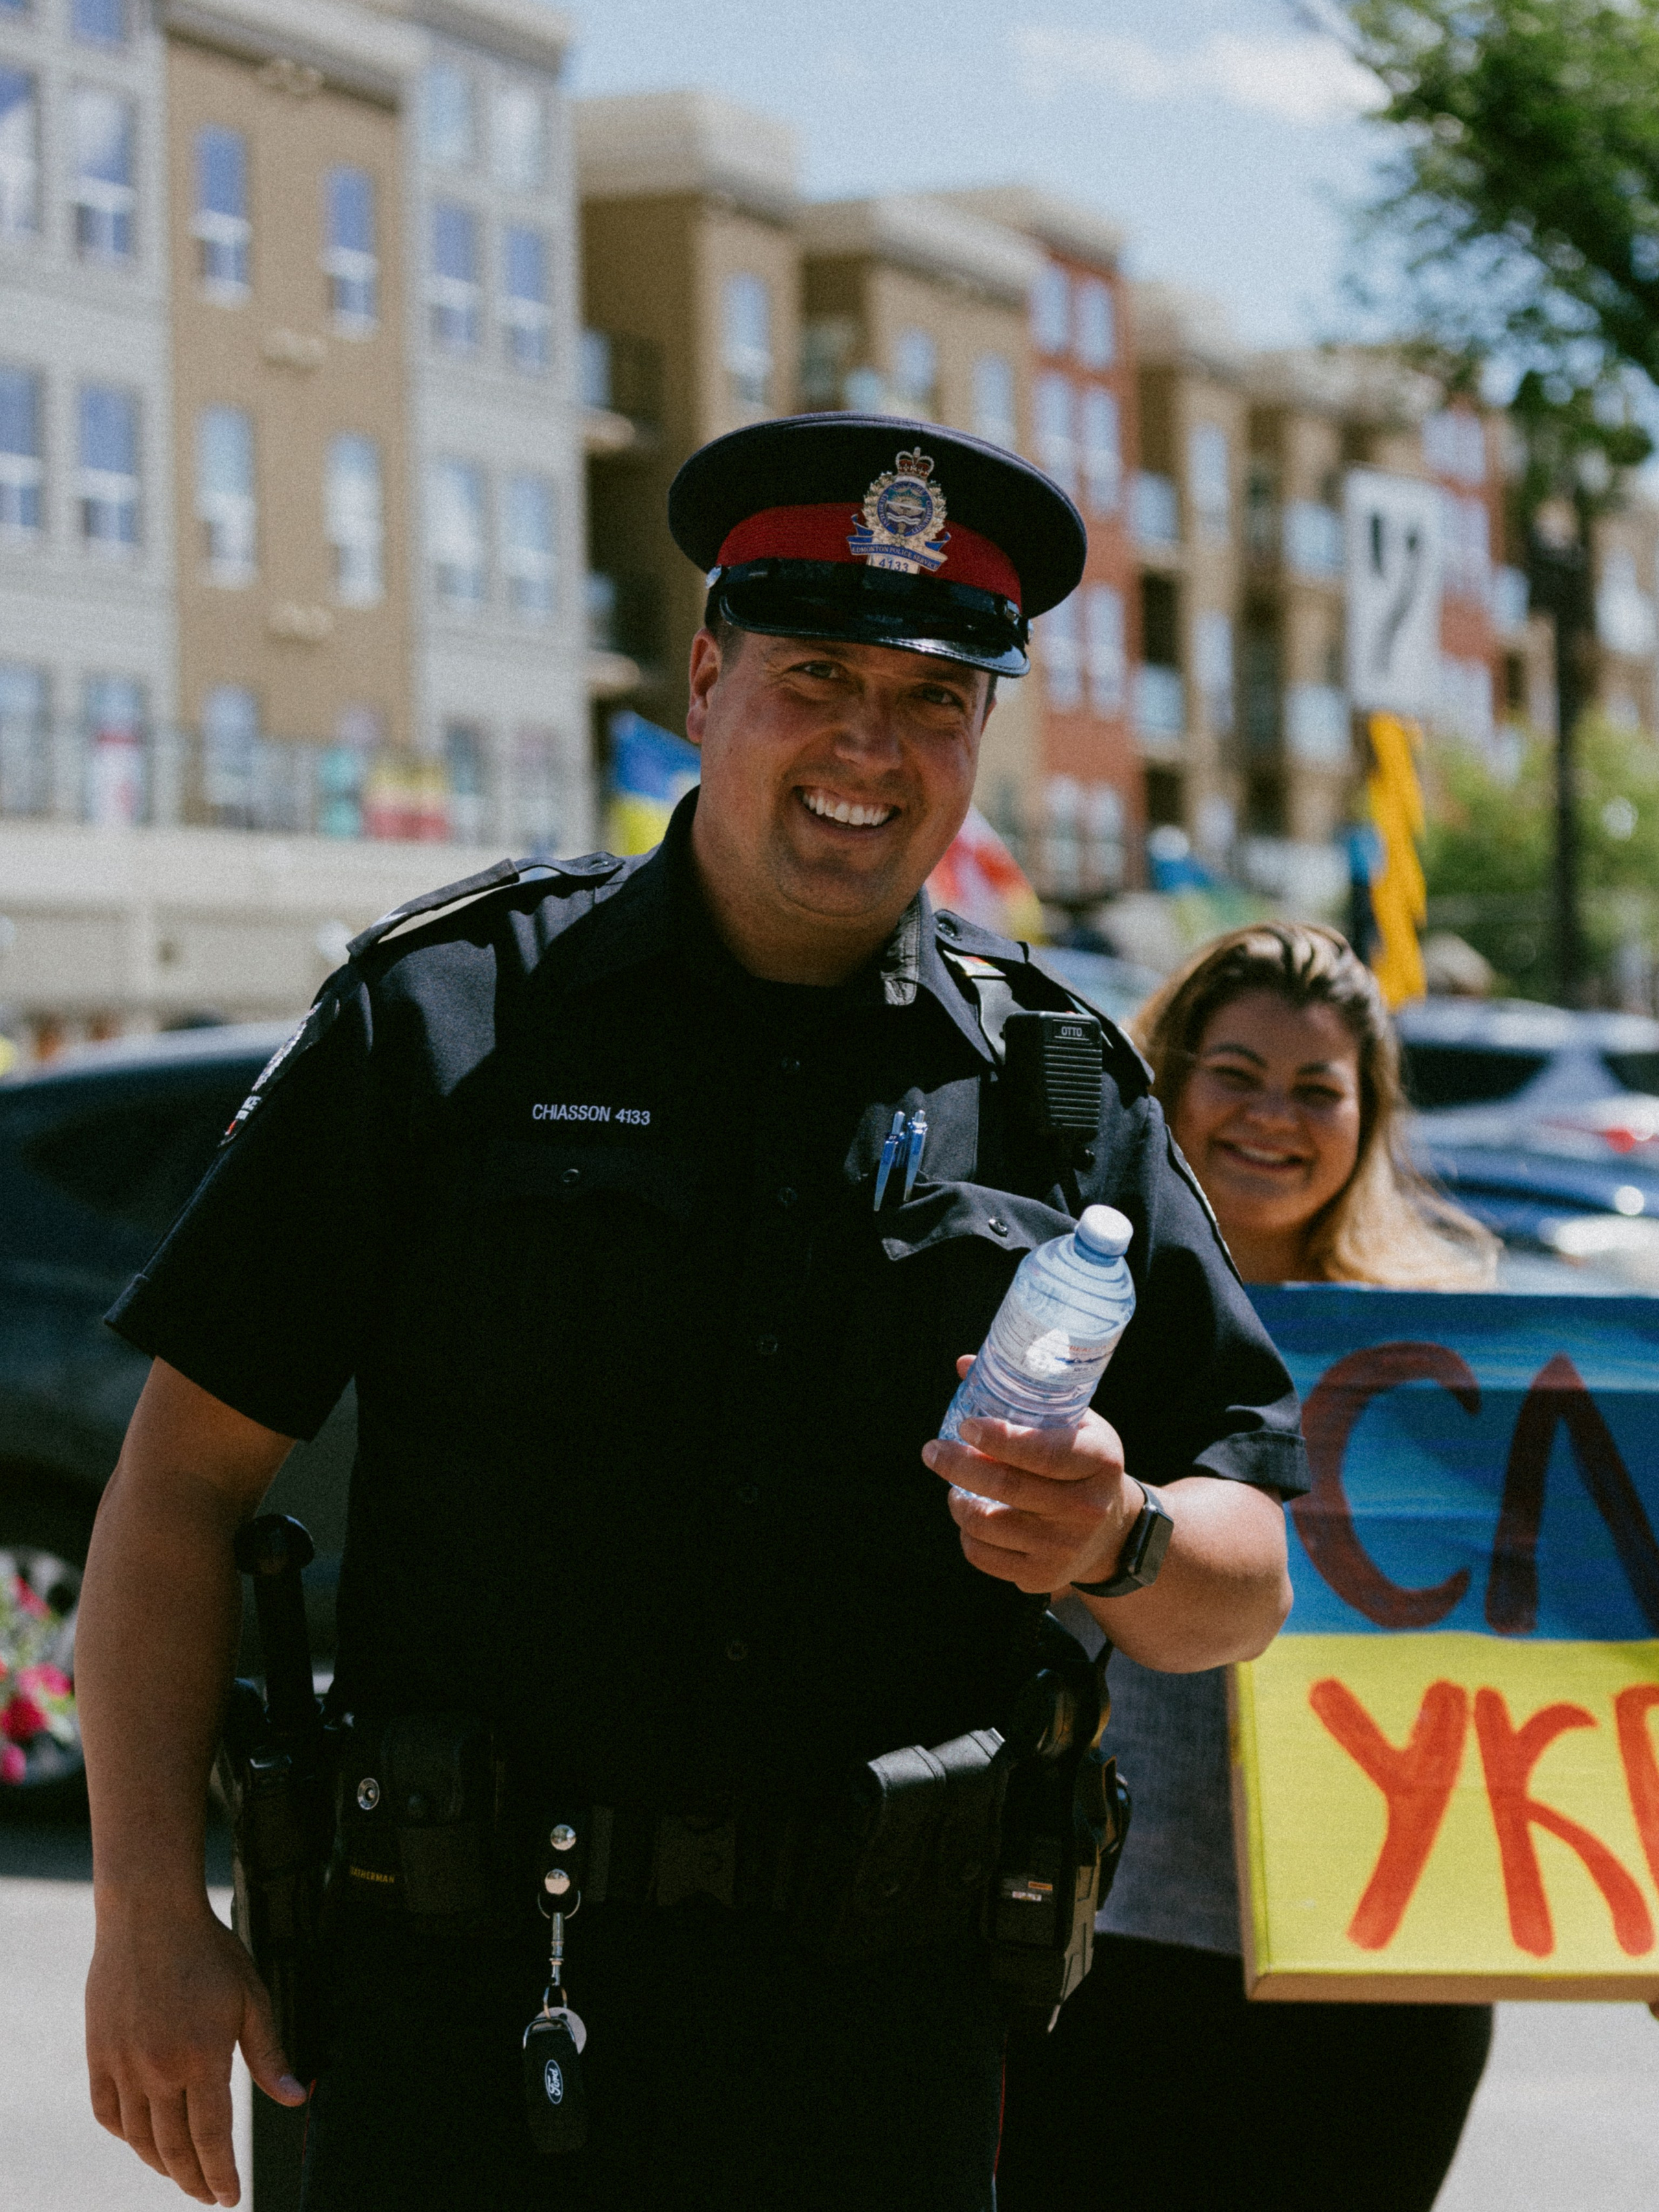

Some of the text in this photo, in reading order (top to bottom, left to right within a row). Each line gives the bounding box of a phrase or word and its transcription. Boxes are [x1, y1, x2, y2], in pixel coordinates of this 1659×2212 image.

[879, 559, 909, 572] 4133
[890, 547, 912, 558] POLICE
[914, 555, 938, 570] SERVICE
[1061, 1026, 1082, 1037] OTTO
[532, 1104, 651, 1126] CHIASSON 4133
[548, 2067, 561, 2096] Ford
